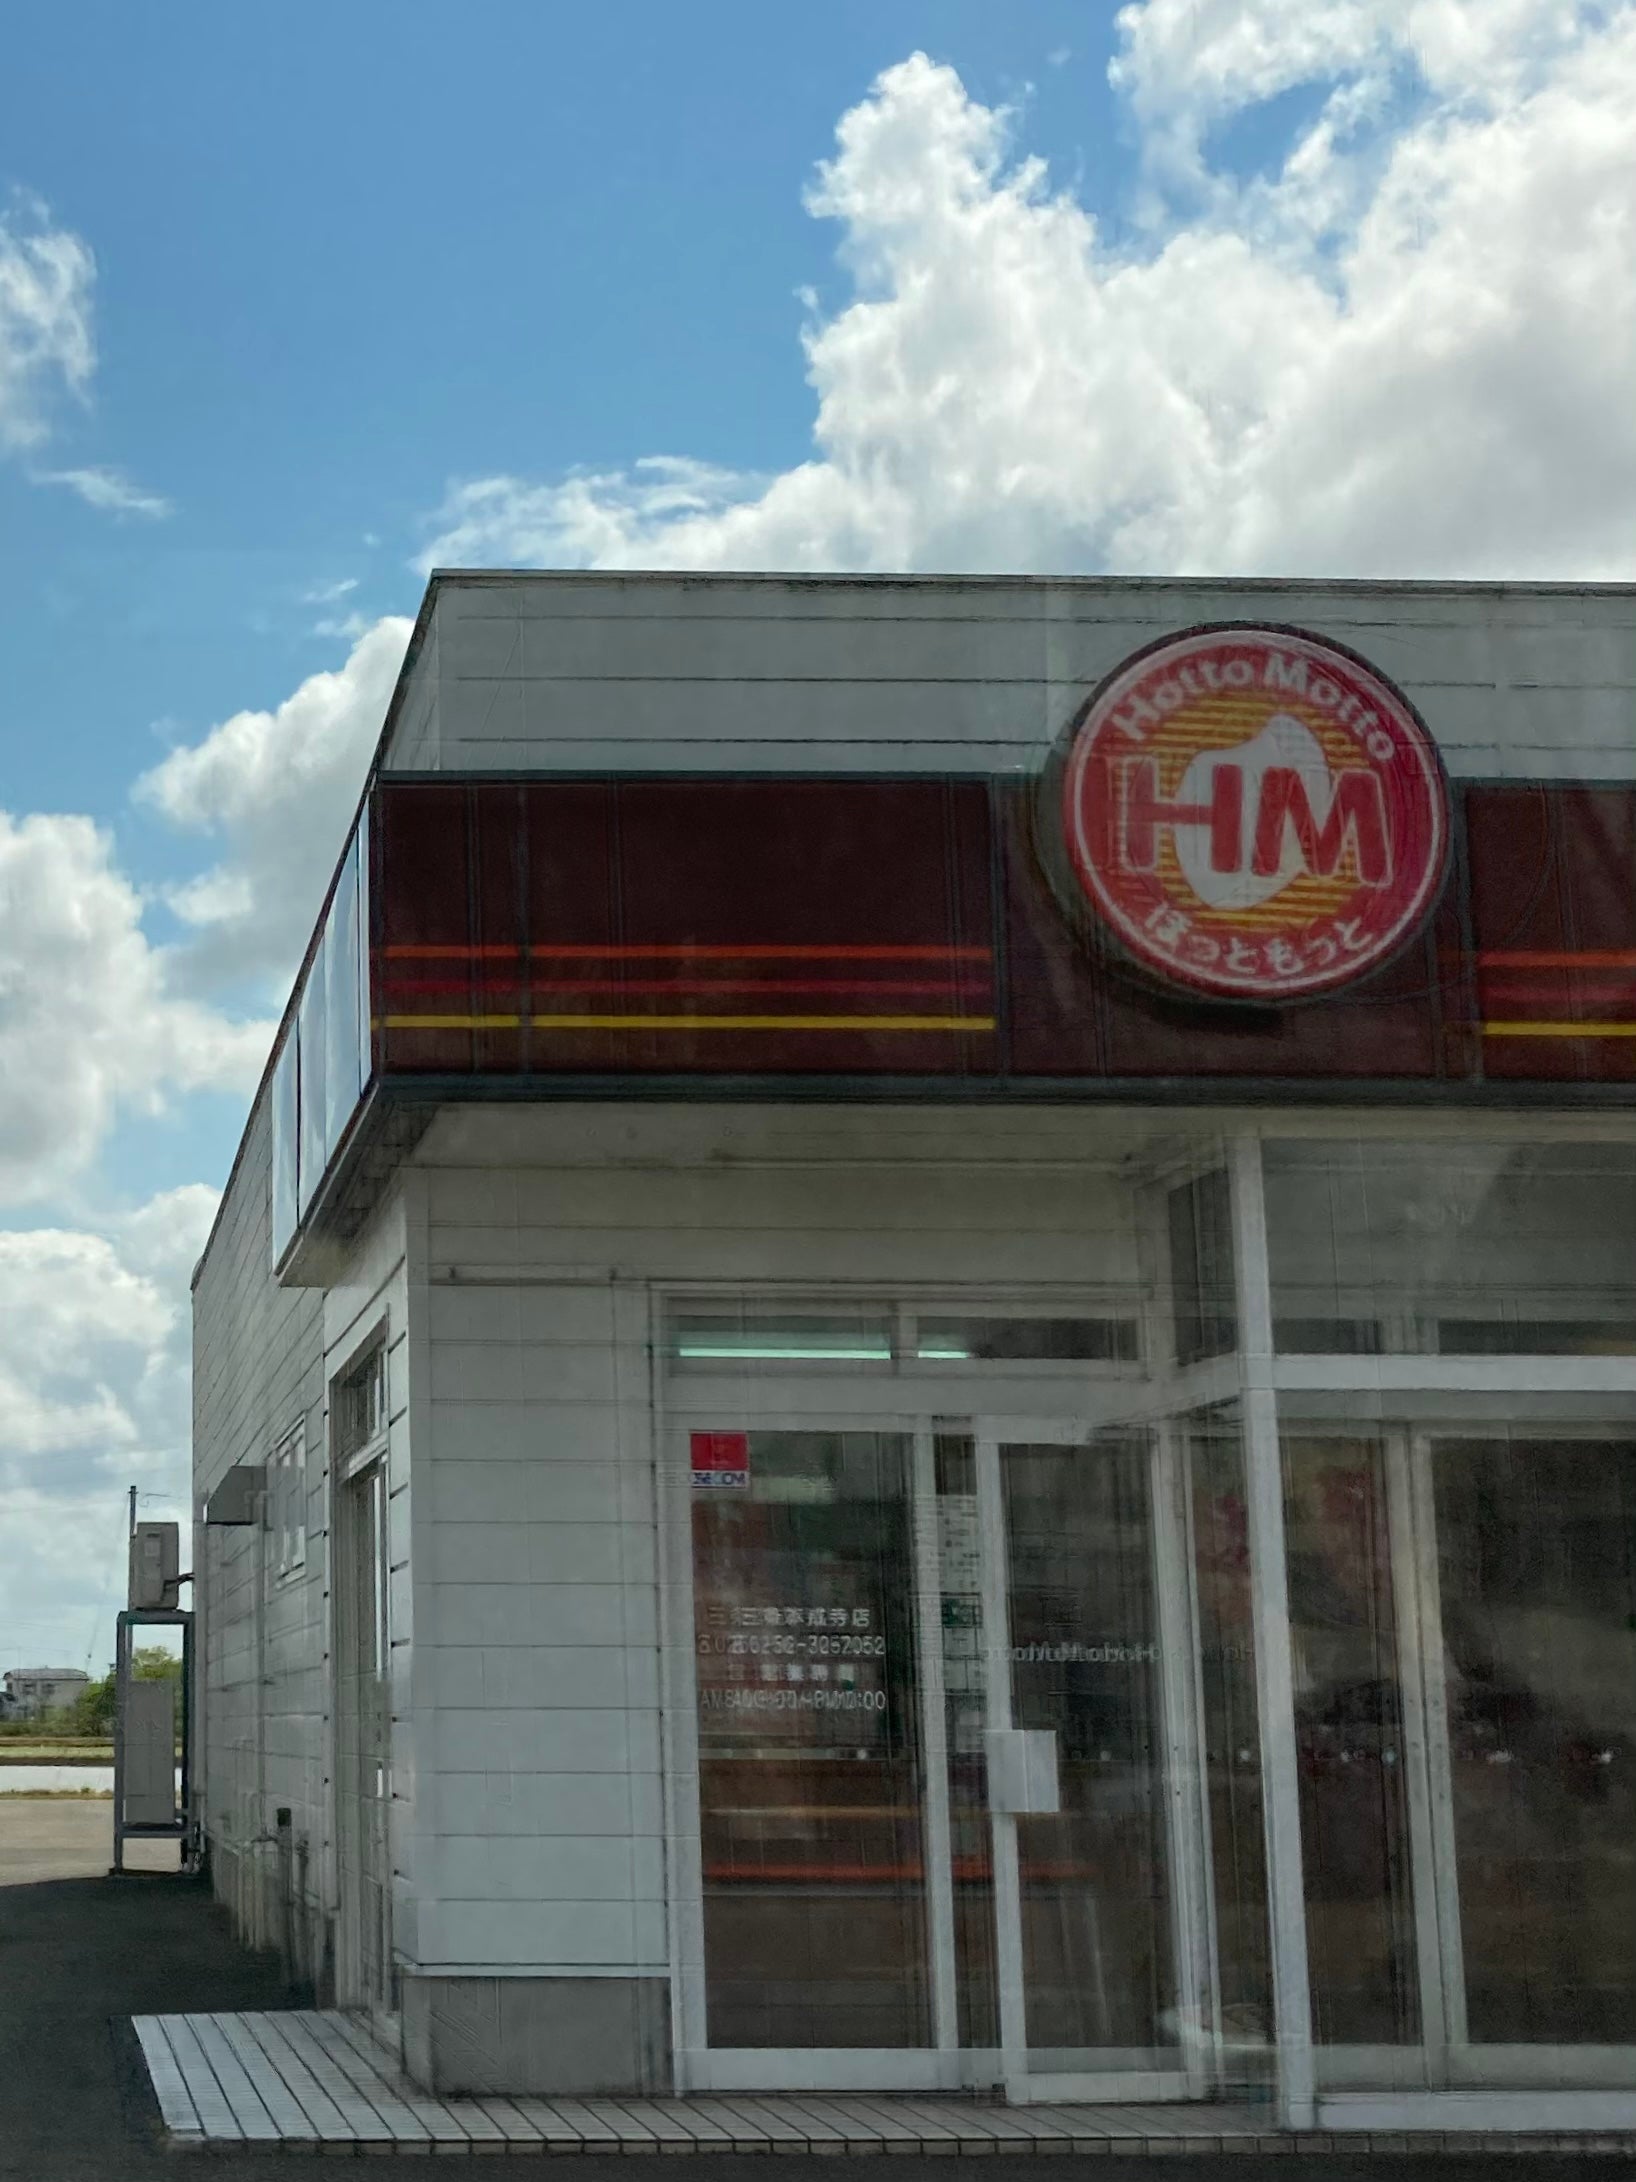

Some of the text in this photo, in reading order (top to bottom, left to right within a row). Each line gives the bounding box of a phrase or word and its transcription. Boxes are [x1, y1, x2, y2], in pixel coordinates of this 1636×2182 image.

[1111, 652, 1396, 762] Hotto Motto
[1119, 754, 1394, 888] HM
[1143, 900, 1373, 977] ほっともっと
